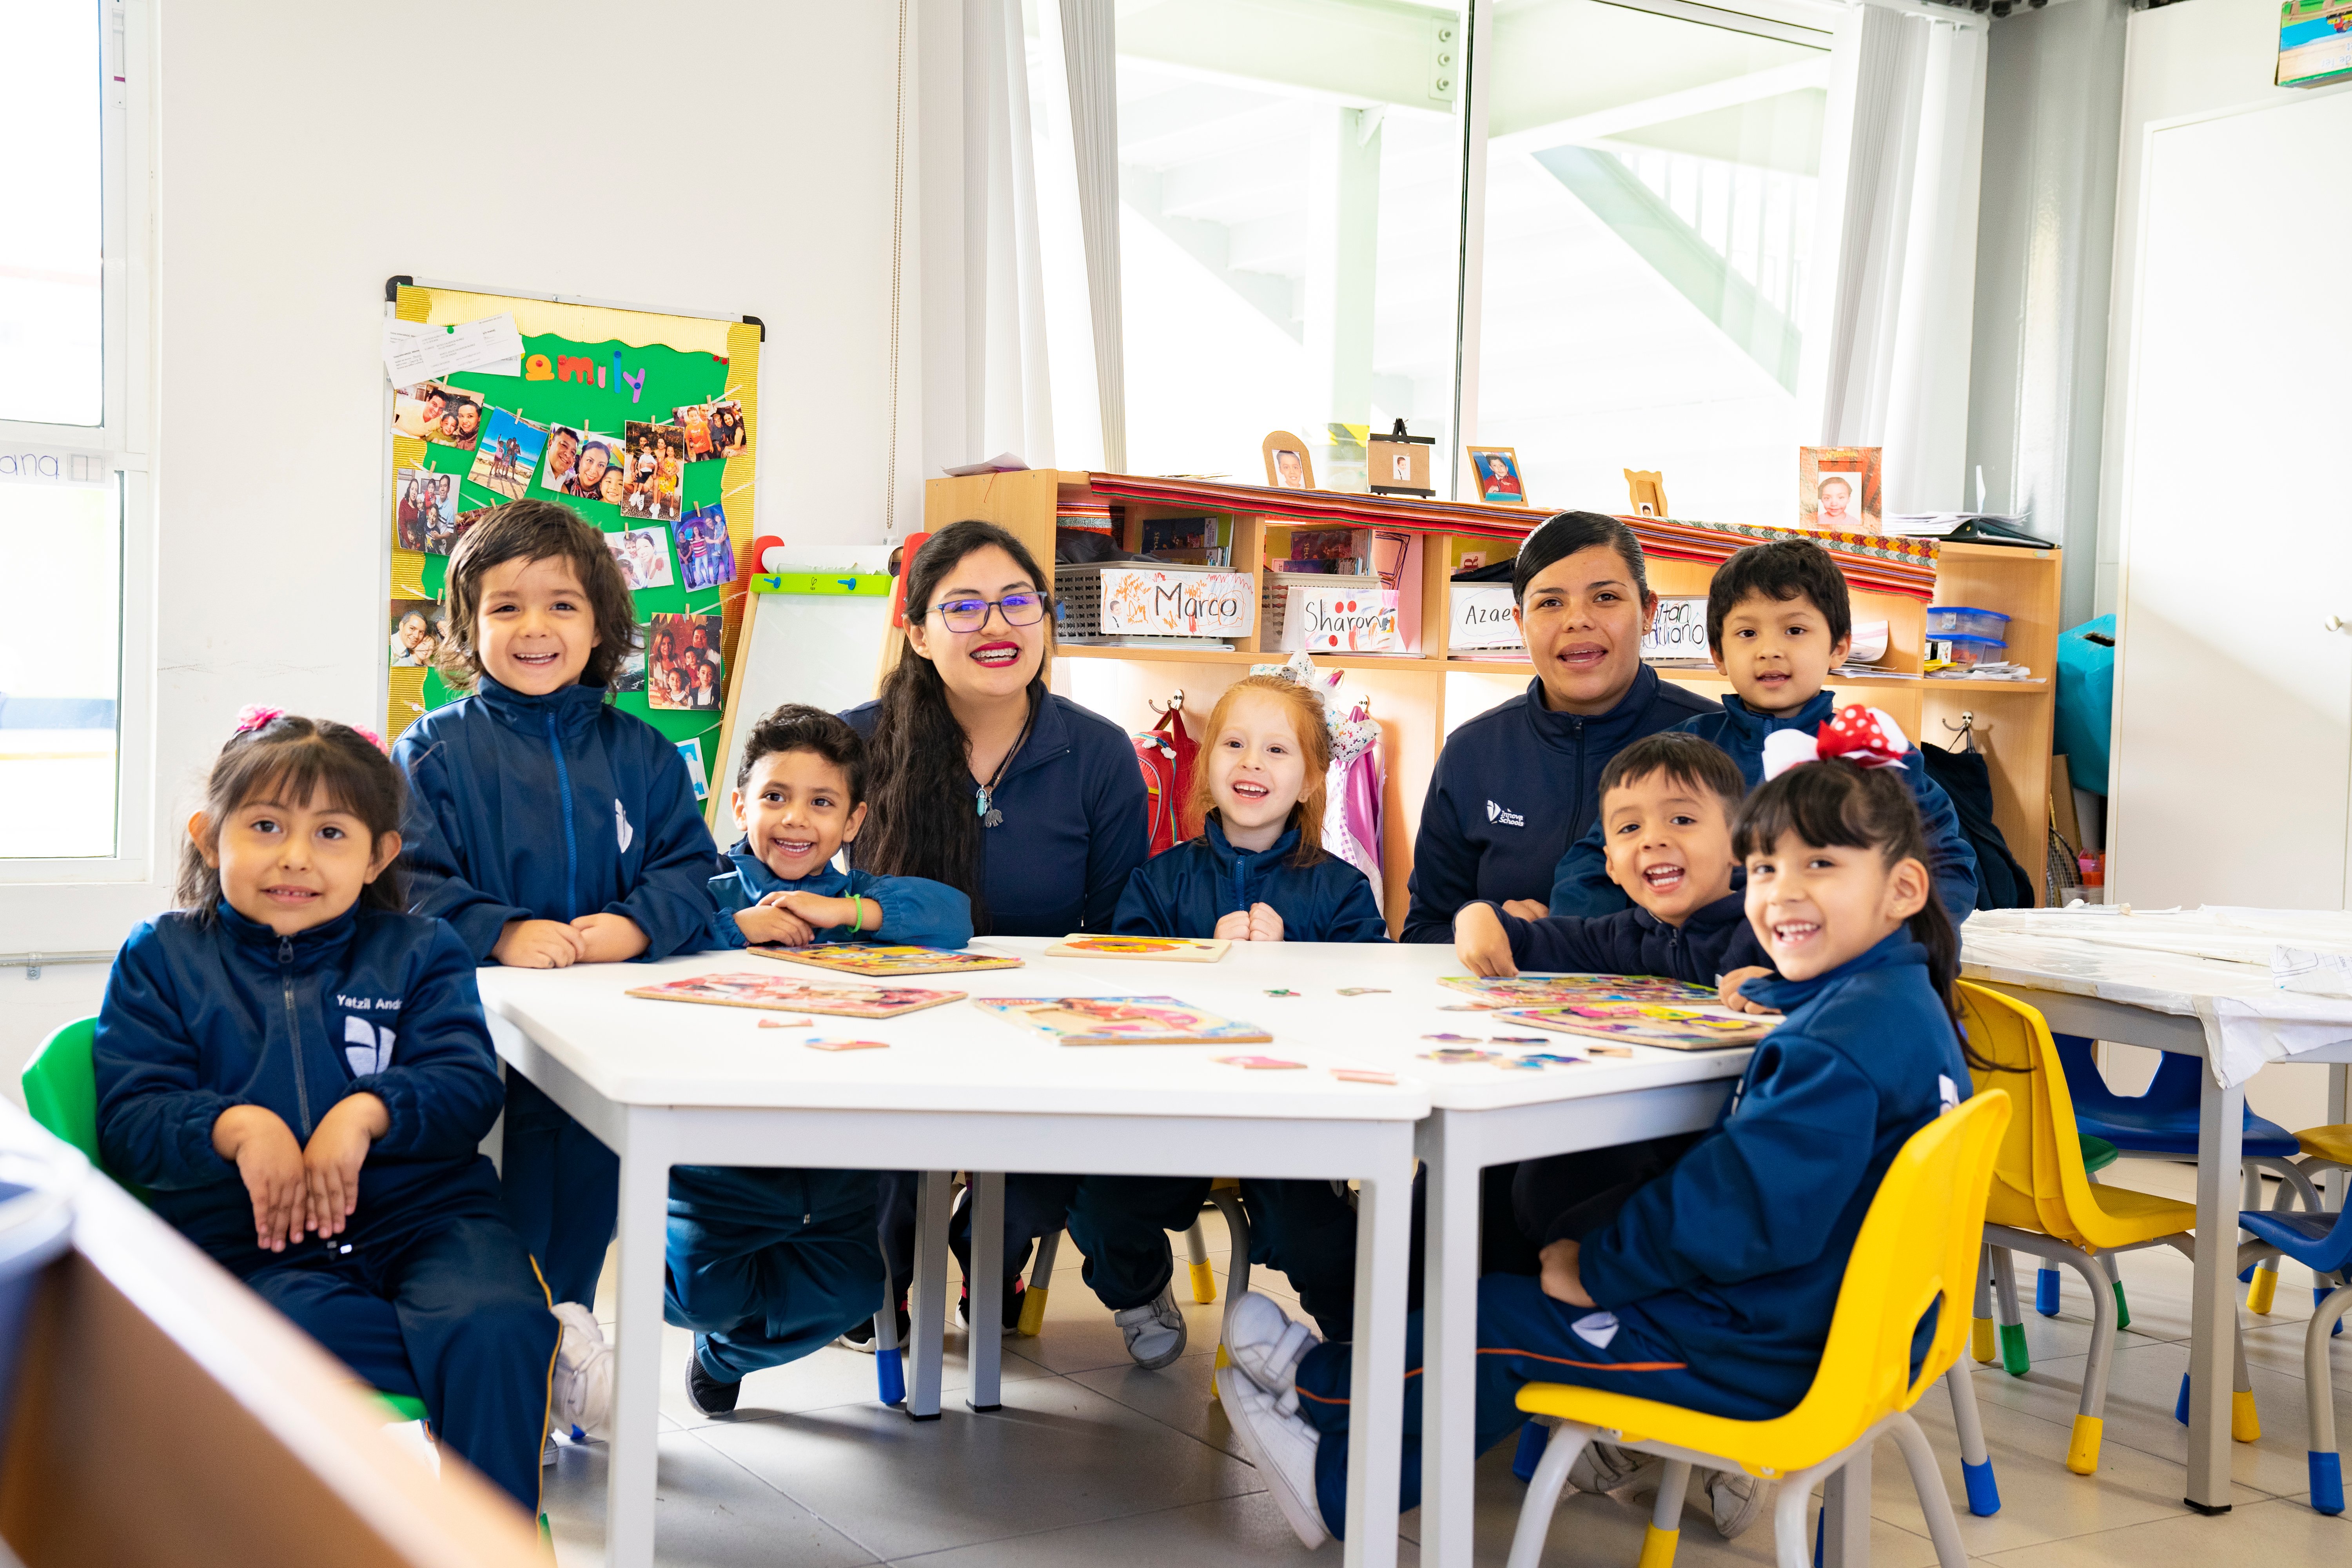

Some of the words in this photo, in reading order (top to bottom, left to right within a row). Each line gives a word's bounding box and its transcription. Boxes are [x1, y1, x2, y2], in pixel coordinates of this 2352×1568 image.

[1156, 583, 1237, 618] Marco
[1305, 599, 1383, 632] Sharon
[1498, 816, 1524, 827] Schools
[1501, 810, 1523, 820] Innova
